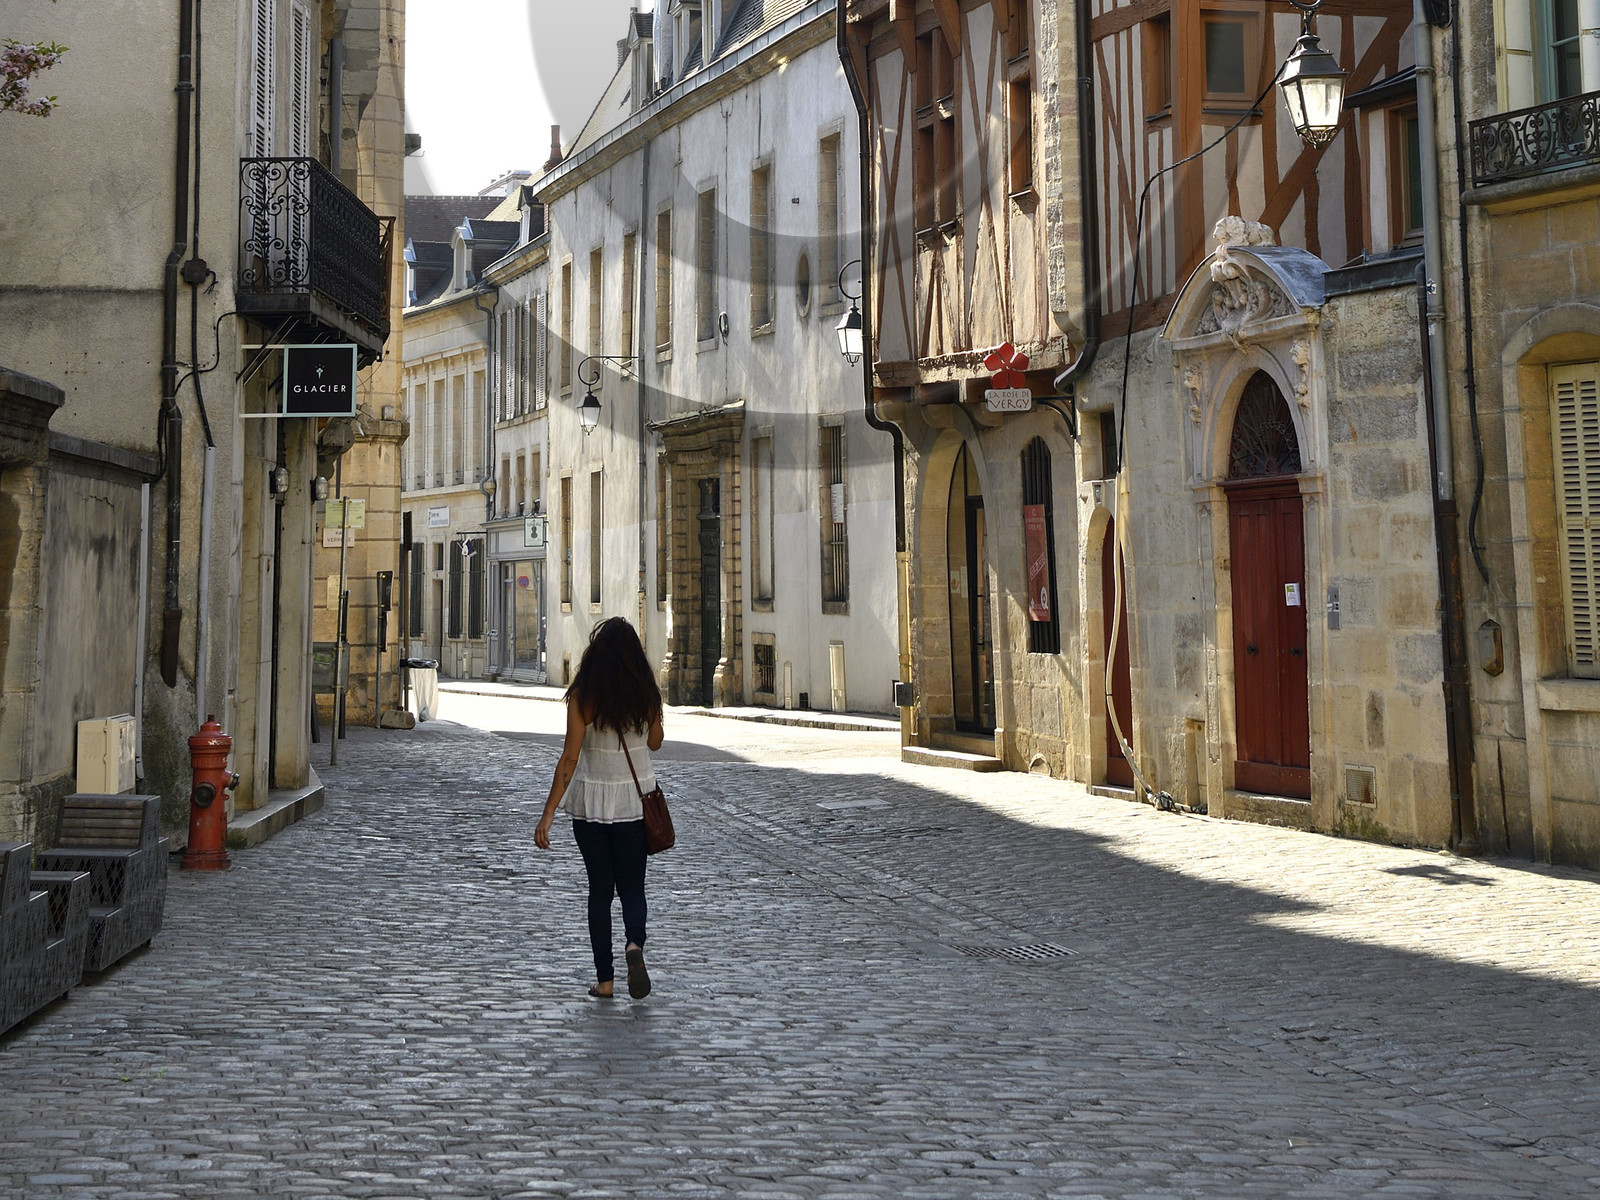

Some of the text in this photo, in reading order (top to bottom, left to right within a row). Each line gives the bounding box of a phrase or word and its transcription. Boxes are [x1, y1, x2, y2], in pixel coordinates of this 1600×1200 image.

[293, 384, 347, 394] GLACIER
[989, 390, 1030, 399] LA ROSE DE
[989, 398, 1030, 409] VERGY
